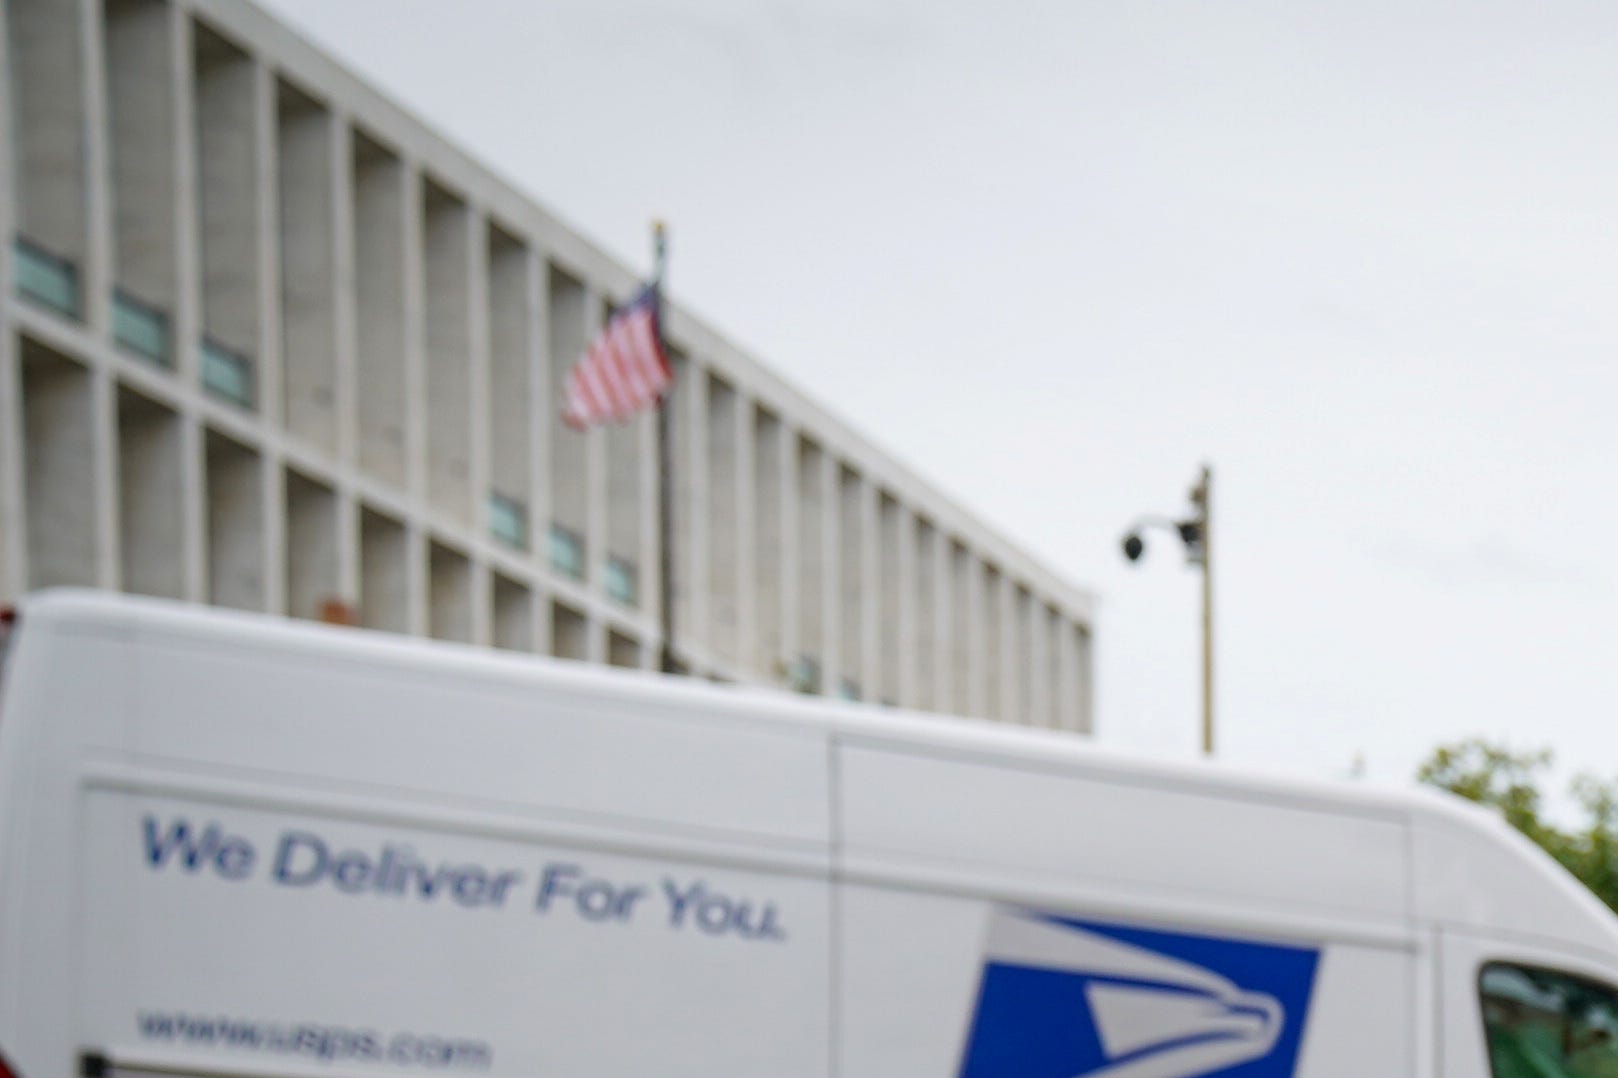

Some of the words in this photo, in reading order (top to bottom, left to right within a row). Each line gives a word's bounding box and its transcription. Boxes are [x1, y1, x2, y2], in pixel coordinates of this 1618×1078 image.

[141, 815, 255, 880] We
[271, 831, 523, 909] Deliver
[534, 863, 648, 926] For
[660, 877, 790, 944] You.
[136, 1008, 493, 1071] www.usps.com
